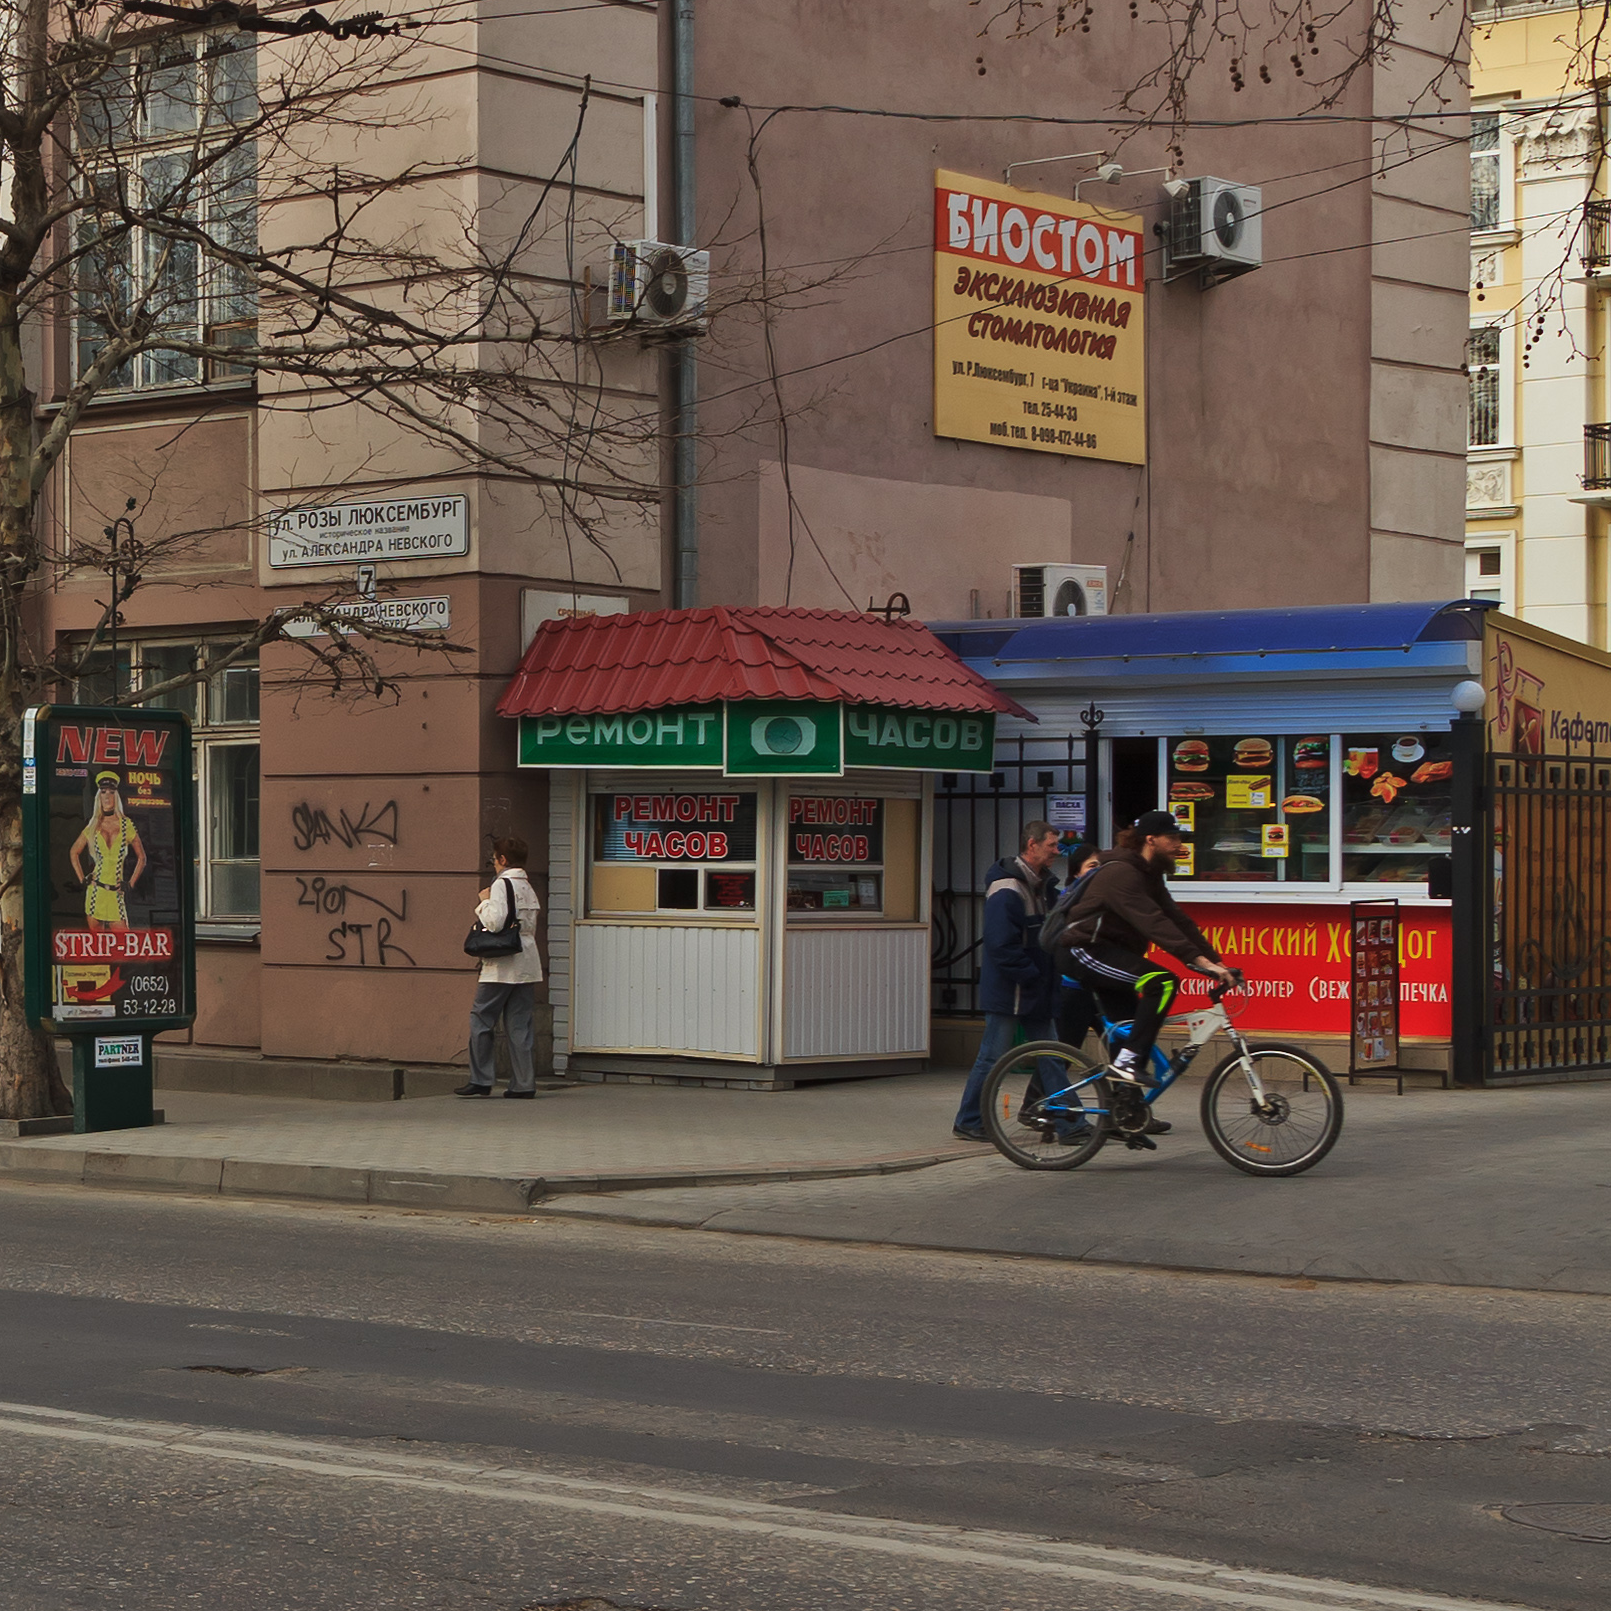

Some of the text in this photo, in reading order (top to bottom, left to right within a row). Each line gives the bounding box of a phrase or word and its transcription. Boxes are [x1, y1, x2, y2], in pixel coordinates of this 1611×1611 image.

[947, 192, 1136, 286] БИОСТОМ
[954, 266, 1131, 329] ЭКСКЛЮЗИВНАЯ
[968, 312, 1117, 360] СТОМАТОЛОГИЯ
[1023, 401, 1040, 415] тел.
[990, 422, 1009, 438] моб.
[1010, 425, 1028, 440] тел.
[272, 500, 462, 536] ул. РОЗЫ ЛЮКСЕМБУРГ
[319, 525, 411, 539] историческое название
[282, 533, 453, 562] ул. АЛЕКСАНДРА НЕВСКОГО
[360, 571, 373, 592] 7
[380, 601, 446, 618] НЕВСКОГО
[848, 712, 985, 751] ЧАСОВ
[1550, 709, 1611, 749] Кафет
[56, 725, 170, 767] NEW
[128, 771, 161, 785] НОЧЬ
[137, 786, 152, 795] без
[613, 795, 740, 823] РЕМОНТ
[789, 797, 877, 825] РЕМОНТ
[624, 830, 728, 859] ЧАСОВ
[796, 834, 869, 862] ЧАСОВ
[130, 976, 169, 995] (0652)
[1220, 980, 1294, 999] АМБУРГЕР
[123, 999, 176, 1015] 53-12-28
[98, 1044, 139, 1056] PARTNER
